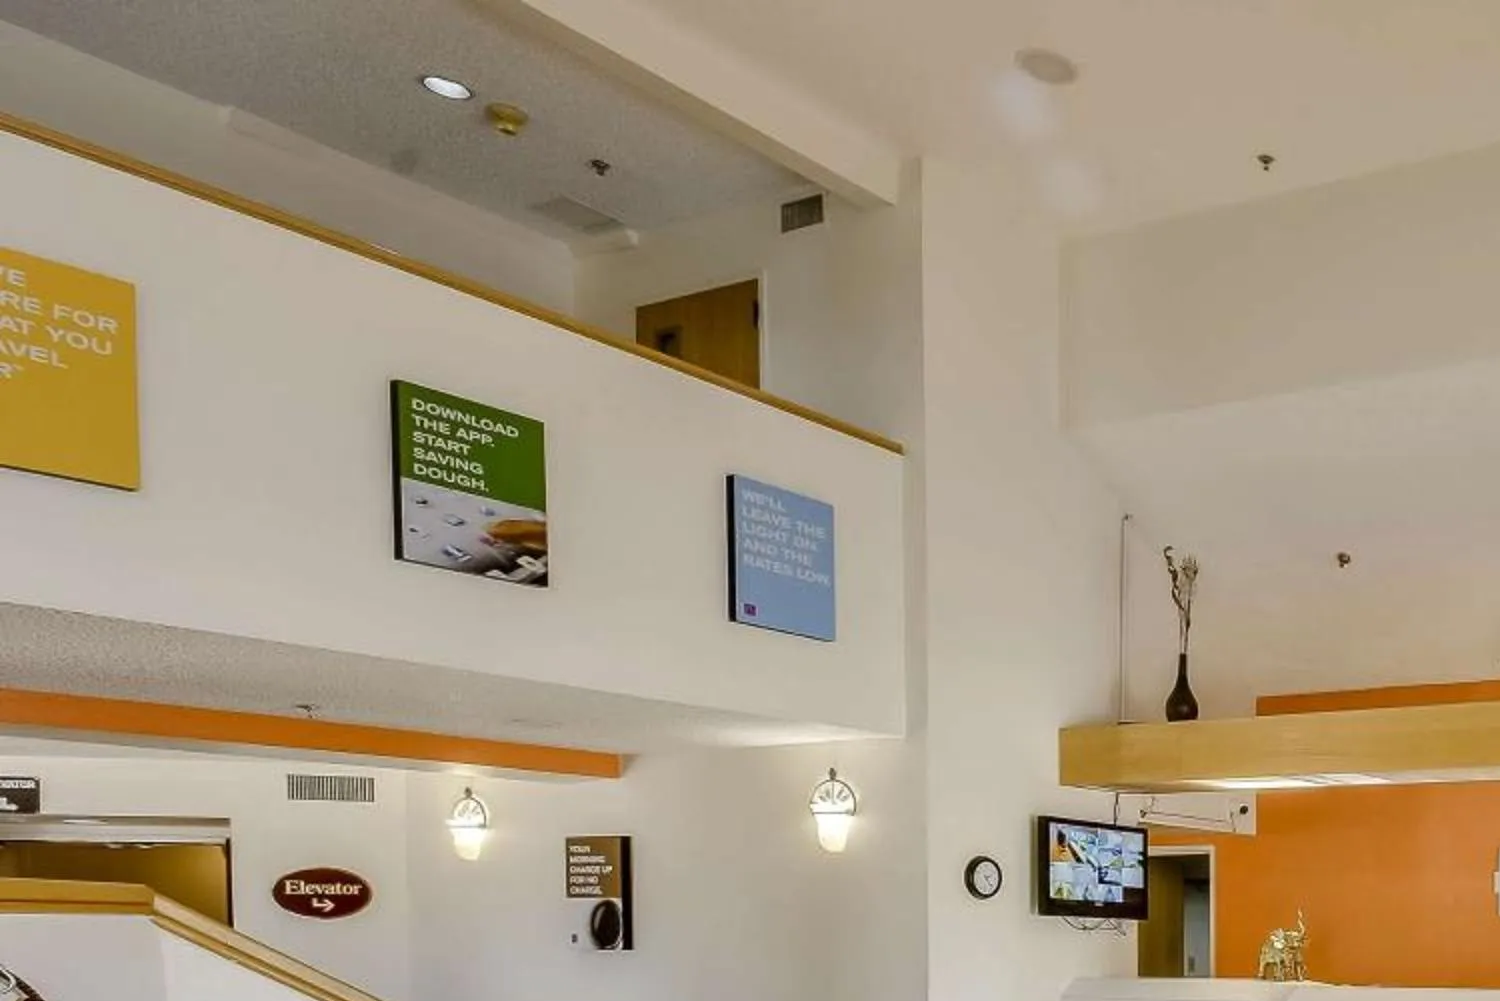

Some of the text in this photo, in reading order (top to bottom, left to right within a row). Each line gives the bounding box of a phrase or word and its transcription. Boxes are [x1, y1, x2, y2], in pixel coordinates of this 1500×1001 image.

[53, 303, 119, 335] FOR
[44, 324, 112, 356] YOU
[411, 398, 520, 438] DOWNLOAD
[411, 413, 495, 448] THE APP.
[413, 431, 471, 456] START
[413, 447, 484, 475] SAVING
[413, 462, 490, 493] DOUGH.
[741, 506, 826, 540] LEAVE THE
[741, 521, 819, 553] LIGHT ON
[743, 537, 813, 568] AND THE
[284, 879, 363, 896] Elevator
